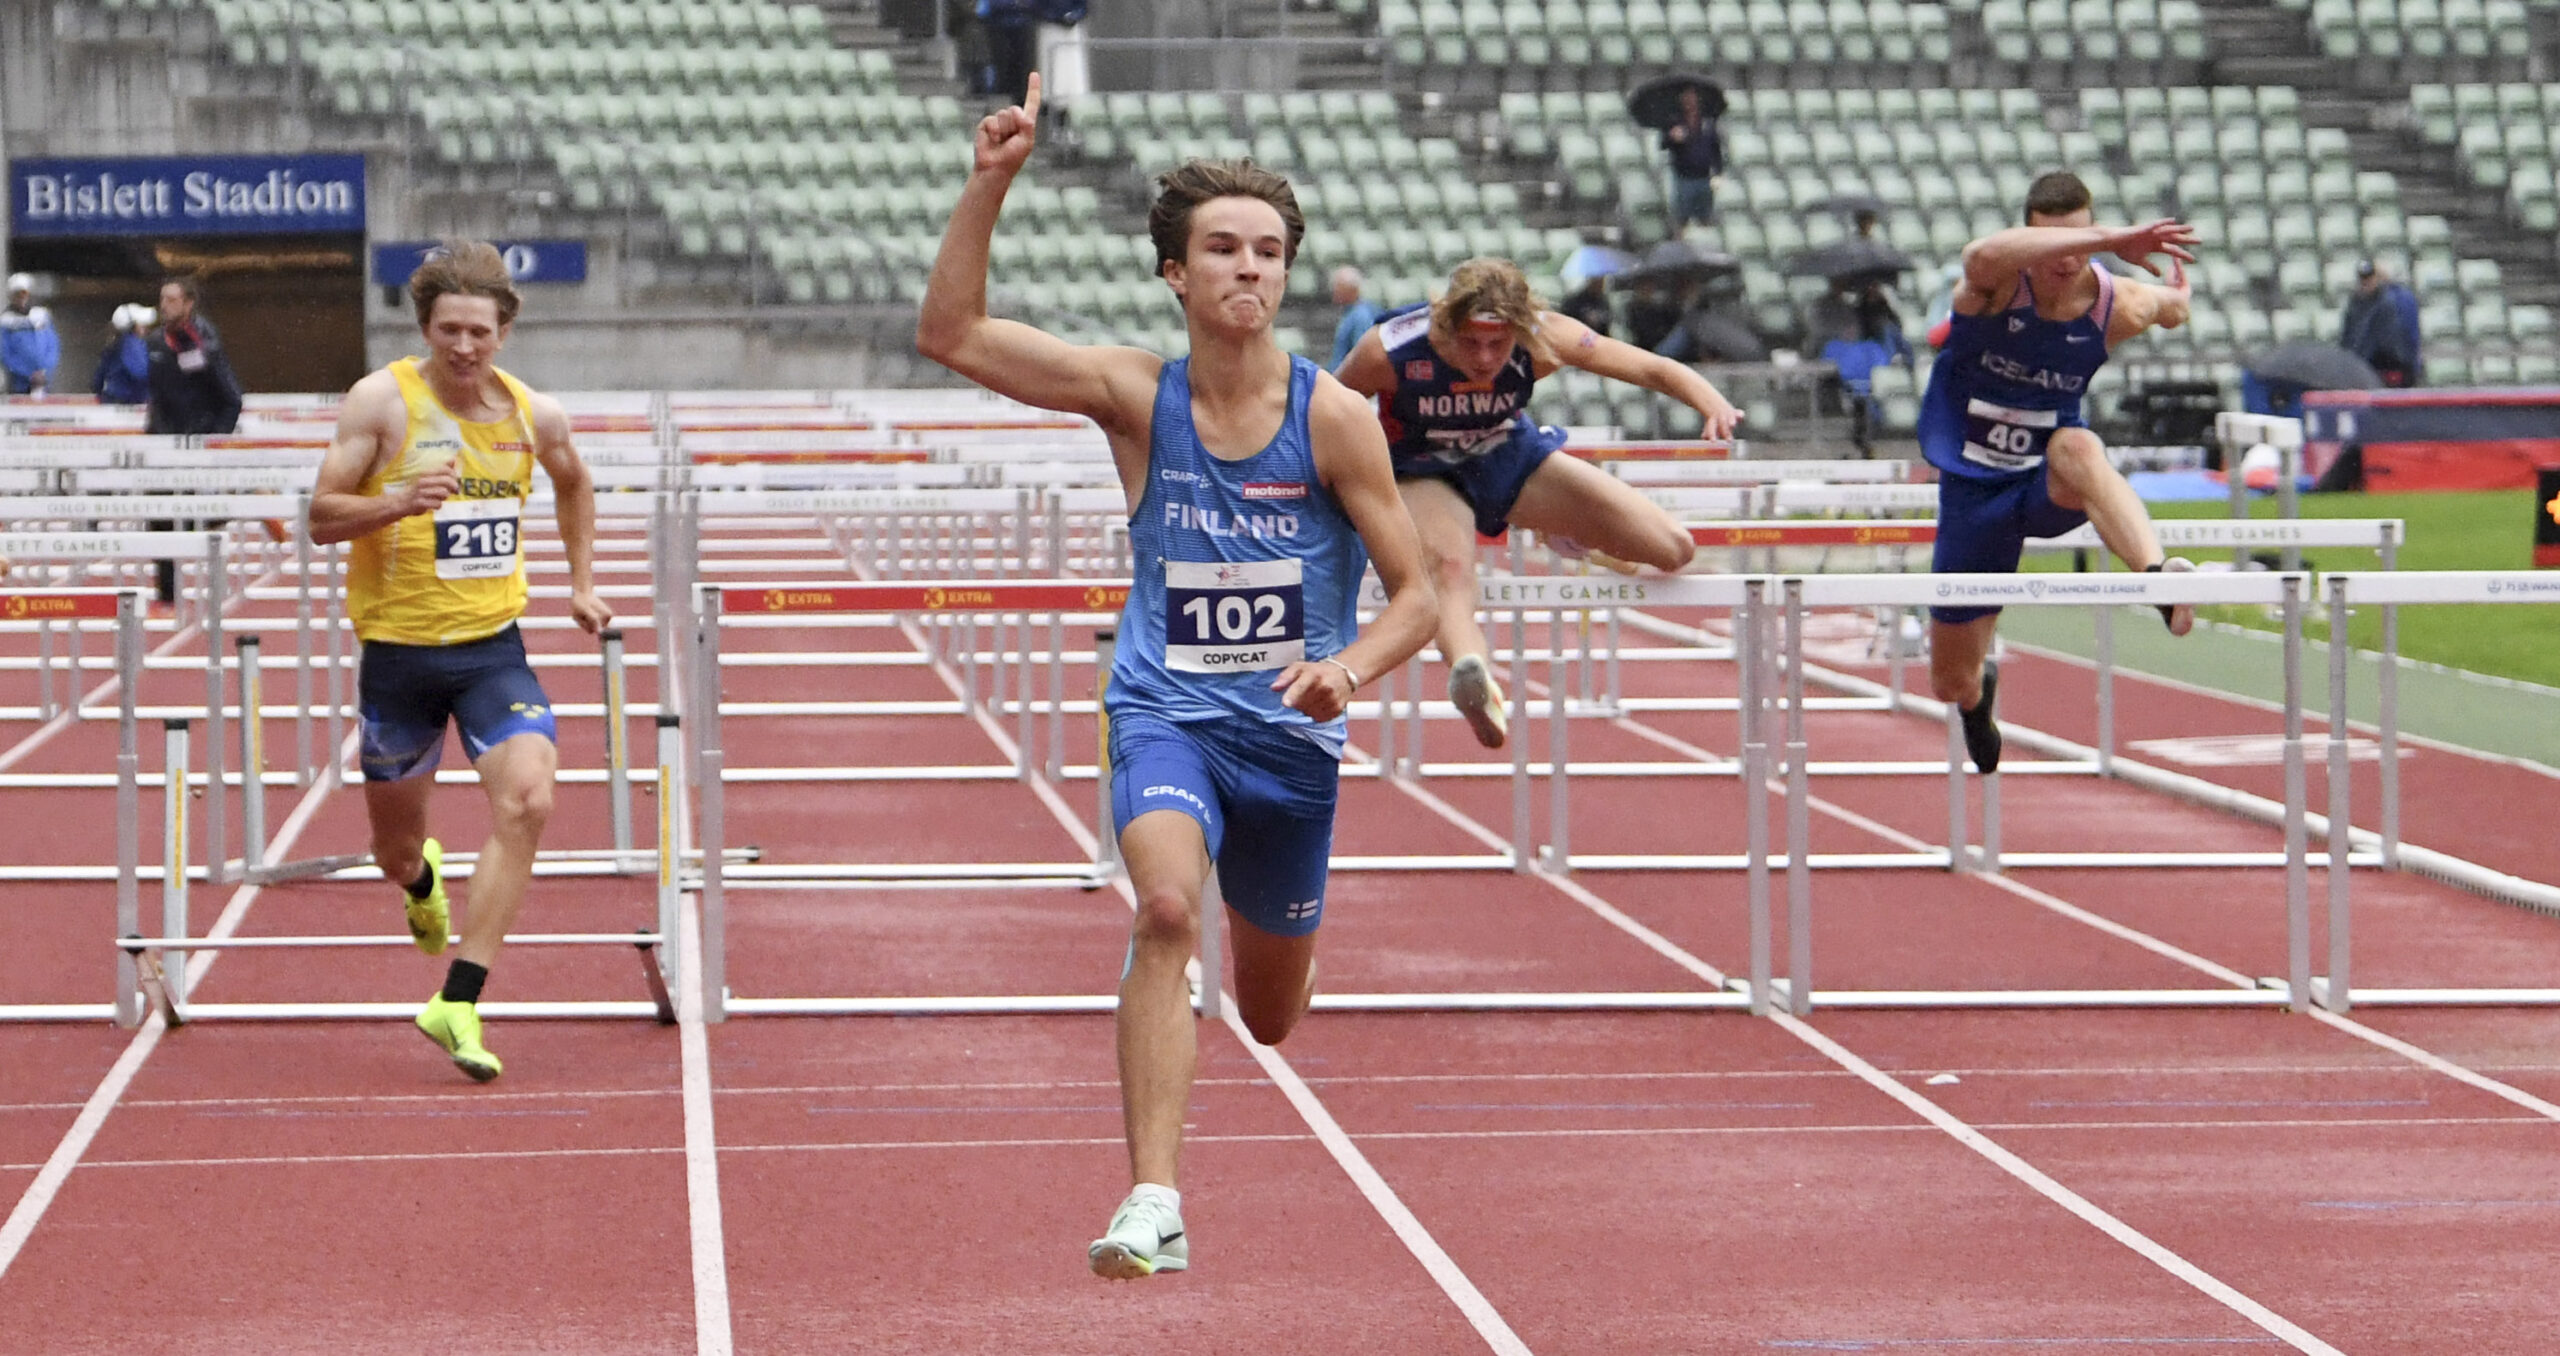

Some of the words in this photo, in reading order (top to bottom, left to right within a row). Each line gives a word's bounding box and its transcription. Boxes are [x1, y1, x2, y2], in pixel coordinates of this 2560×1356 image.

[25, 172, 172, 219] Bislett
[183, 169, 352, 216] Stadion
[1980, 351, 2083, 392] ICELAND
[1418, 391, 1516, 417] NORWAY
[1986, 423, 2032, 453] 40
[457, 478, 520, 498] EDEN
[1245, 485, 1306, 496] motonet
[1165, 502, 1299, 539] FINLAND
[447, 521, 514, 556] 218
[2160, 527, 2220, 540] SLETT
[2232, 527, 2302, 540] GAMES
[52, 541, 121, 552] GAMES
[462, 562, 502, 572] COPYCAT
[1485, 585, 1545, 600] LETT
[1559, 584, 1647, 600] GAMES
[1980, 584, 2024, 595] WANDA
[2048, 583, 2101, 594] DIAMOND
[2103, 583, 2146, 594] LEAGUE
[30, 599, 75, 612] EXTRA
[787, 592, 833, 605] EXTRA
[948, 591, 993, 604] EXTRA
[1182, 594, 1286, 640] 102
[1203, 651, 1268, 665] COPYCAT
[1143, 785, 1206, 810] CRAFT
